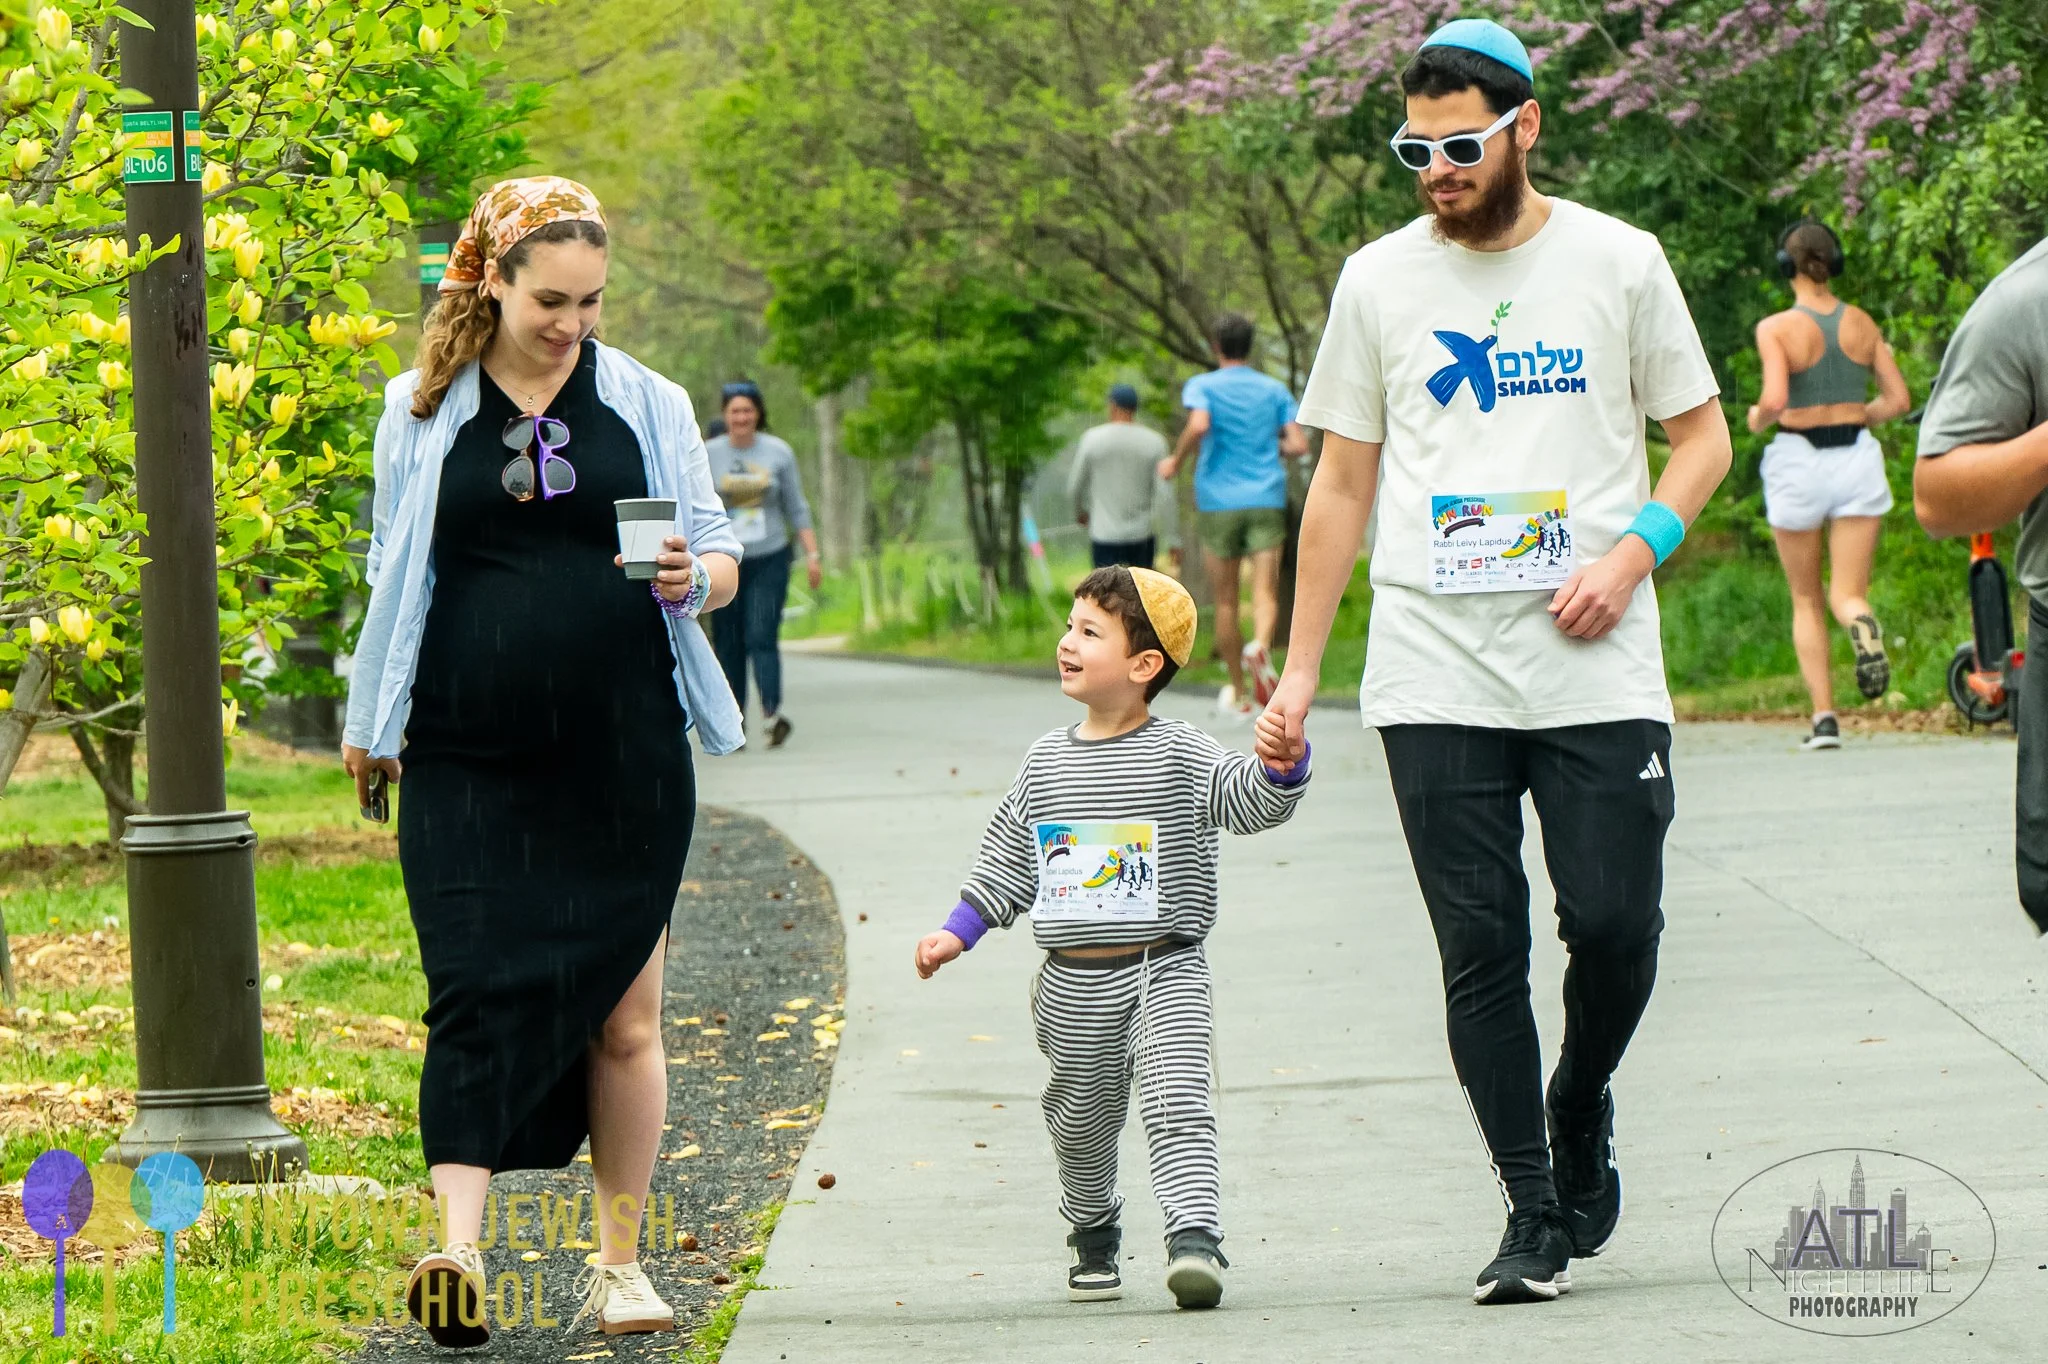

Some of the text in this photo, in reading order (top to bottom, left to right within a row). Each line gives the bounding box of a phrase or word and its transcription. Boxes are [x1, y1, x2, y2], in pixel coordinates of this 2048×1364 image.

[125, 154, 168, 174] BL-106
[1495, 340, 1583, 379] שלום
[1497, 377, 1587, 397] SHALOM
[1462, 504, 1495, 517] RUN
[1433, 540, 1454, 548] Rabbi
[1479, 538, 1512, 548] Lapidus
[1055, 833, 1079, 846] RUN
